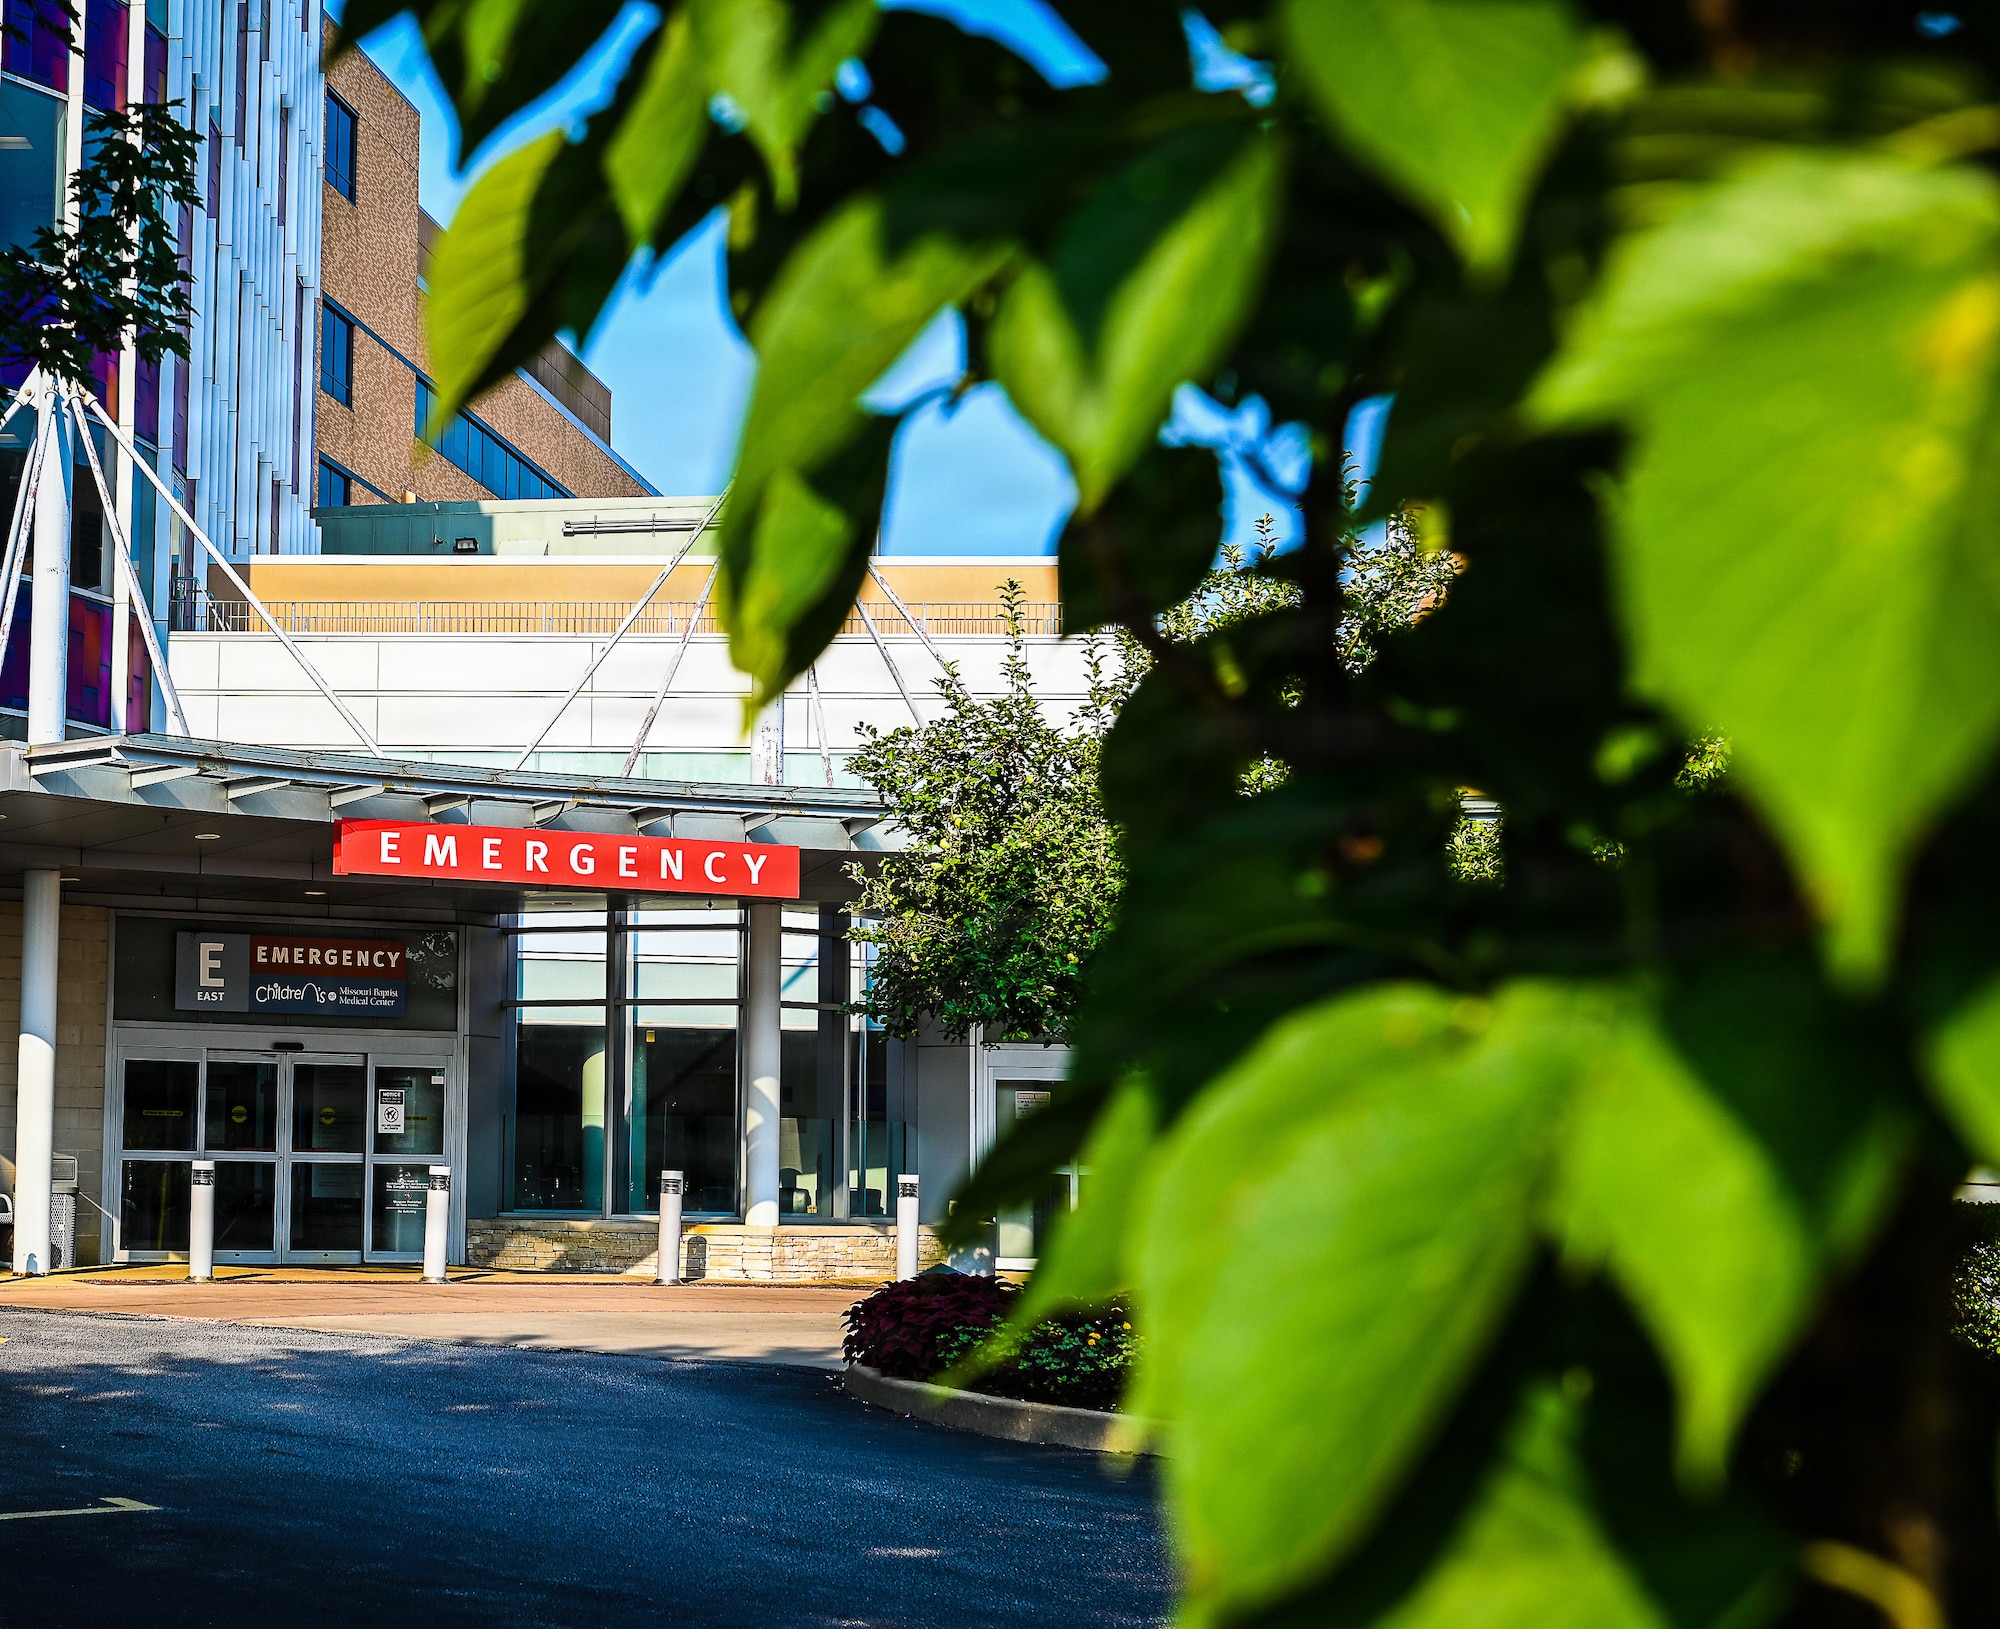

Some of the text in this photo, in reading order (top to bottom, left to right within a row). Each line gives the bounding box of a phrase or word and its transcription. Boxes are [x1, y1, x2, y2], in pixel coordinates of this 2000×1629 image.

[379, 831, 768, 885] EMERGENCY
[199, 942, 225, 988] E
[256, 945, 401, 968] EMERGENCY
[197, 991, 225, 1001] EAST
[339, 986, 399, 998] Missouri Baptist
[339, 996, 396, 1006] Medical Center
